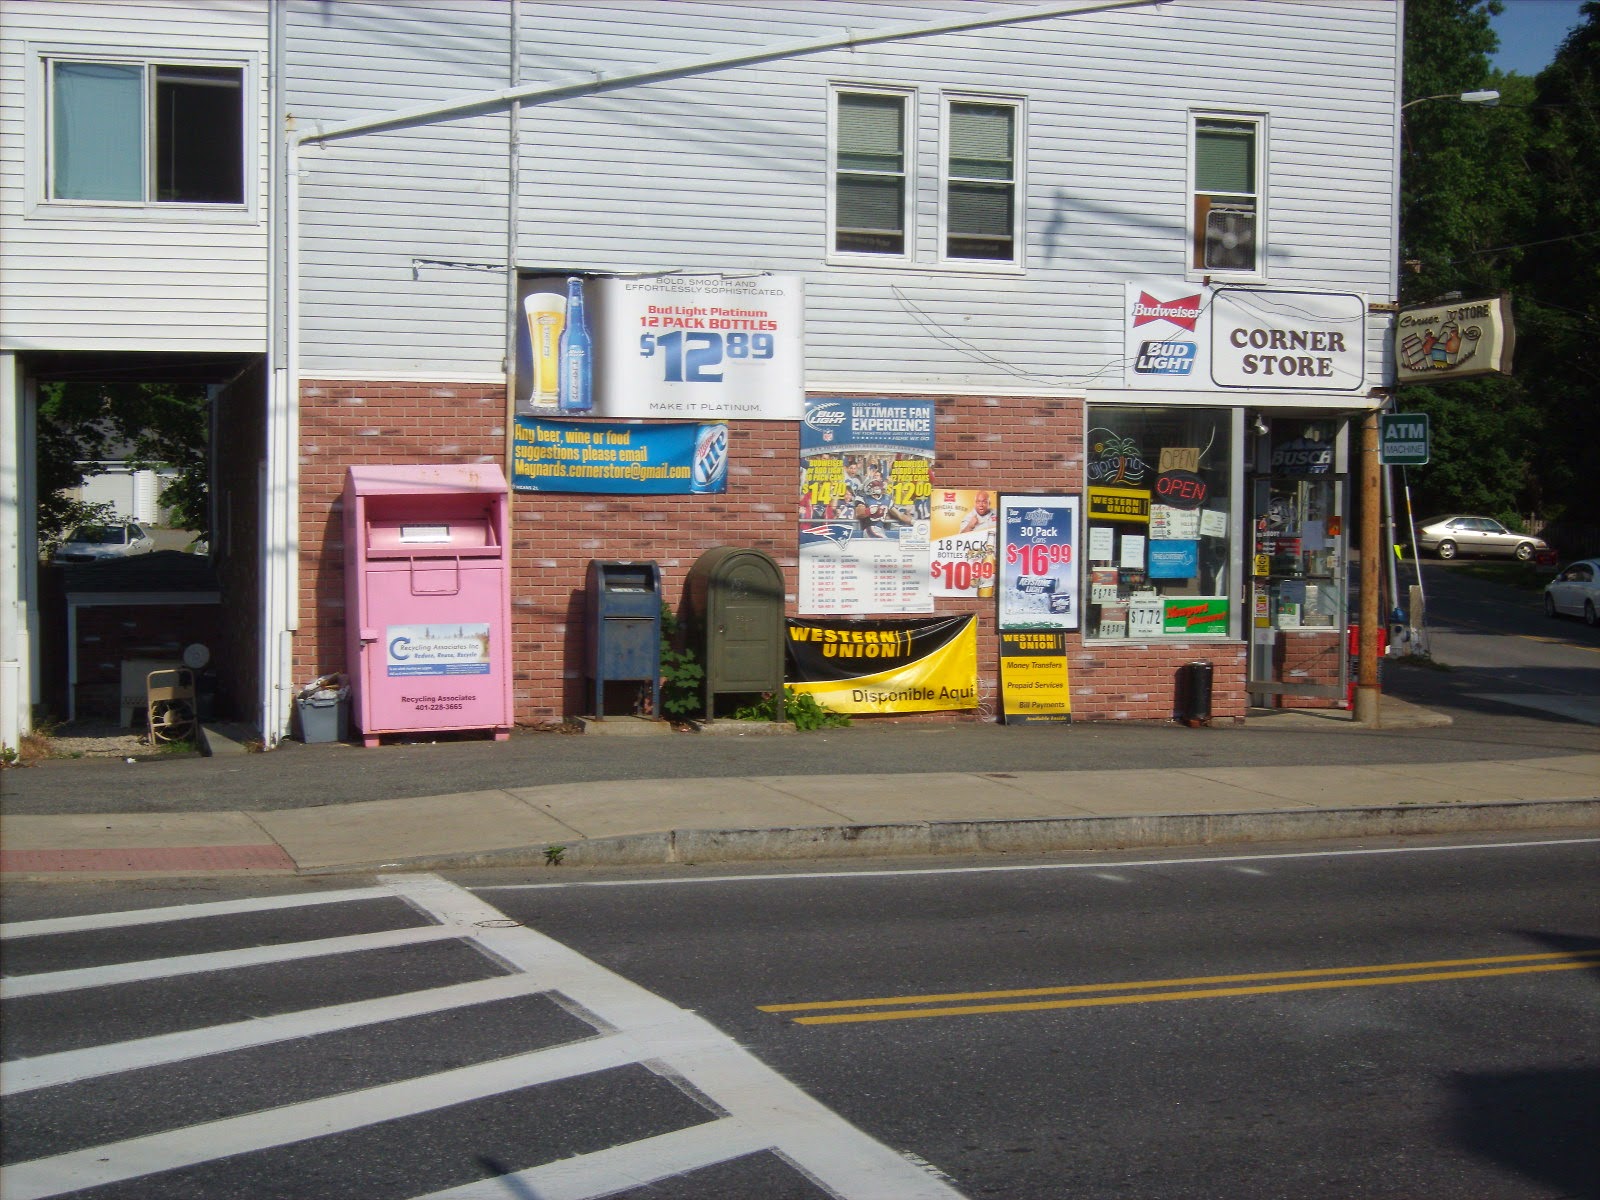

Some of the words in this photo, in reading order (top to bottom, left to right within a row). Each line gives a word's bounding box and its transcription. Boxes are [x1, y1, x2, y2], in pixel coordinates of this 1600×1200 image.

[656, 277, 687, 286] BOLD,
[689, 278, 732, 287] SMOOTH
[734, 280, 757, 288] AND
[625, 284, 702, 294] EFFORTLESSLY
[705, 287, 786, 297] SOPHISTICATED.
[648, 305, 673, 315] Bud
[675, 306, 708, 318] Light
[710, 307, 768, 318] Platinum
[1132, 303, 1203, 320] Budweiser
[1400, 314, 1441, 328] Corner
[1457, 304, 1490, 321] STORE
[640, 316, 659, 328] 12
[662, 317, 705, 329] PACK
[708, 318, 778, 331] BOTTLES
[1230, 327, 1346, 353] CORNER
[1147, 342, 1190, 357] BUD
[1137, 356, 1194, 371] LIGHT
[1242, 353, 1334, 378] STORE
[649, 402, 683, 411] MAKE
[686, 403, 697, 411] IT
[700, 403, 763, 412] PLATINUM.
[852, 406, 907, 419] ULTIMATE
[909, 407, 930, 419] FAN
[810, 416, 847, 424] LIGHT
[816, 410, 845, 418] BUD
[851, 418, 930, 432] EXPERIENCE
[1385, 423, 1424, 439] ATM
[514, 424, 535, 444] Any
[537, 426, 564, 444] beer,
[565, 428, 591, 444] wine
[593, 432, 604, 445] or
[606, 429, 630, 445] food
[515, 444, 580, 461] suggestions
[582, 446, 617, 463] please
[619, 445, 648, 462] email
[1386, 444, 1424, 455] MACHINE
[1161, 449, 1196, 470] OPEN
[515, 459, 691, 482] Maynards.cornerstore@gmail.com
[1156, 477, 1207, 500] OPEN
[1092, 496, 1139, 506] WESTERN
[1107, 504, 1139, 514] UNION
[1020, 526, 1034, 537] 30
[1035, 526, 1058, 537] Pack
[938, 539, 953, 551] 18
[956, 539, 988, 552] PACK
[1031, 536, 1047, 544] Cans
[937, 551, 963, 559] BOTTLES
[1018, 578, 1052, 587] KEYSTONE
[789, 626, 897, 644] WESTERN
[1003, 634, 1054, 642] WESTERN
[400, 644, 431, 652] Recycling
[822, 643, 896, 658] UNION
[1019, 641, 1054, 650] UNION
[1006, 661, 1030, 670] Money
[1031, 661, 1063, 669] Transfers
[1007, 682, 1034, 690] Prepaid
[852, 686, 935, 706] Disponible
[939, 684, 974, 702] Aquí
[1019, 701, 1030, 709] Bill
[1031, 701, 1065, 710] Payments
